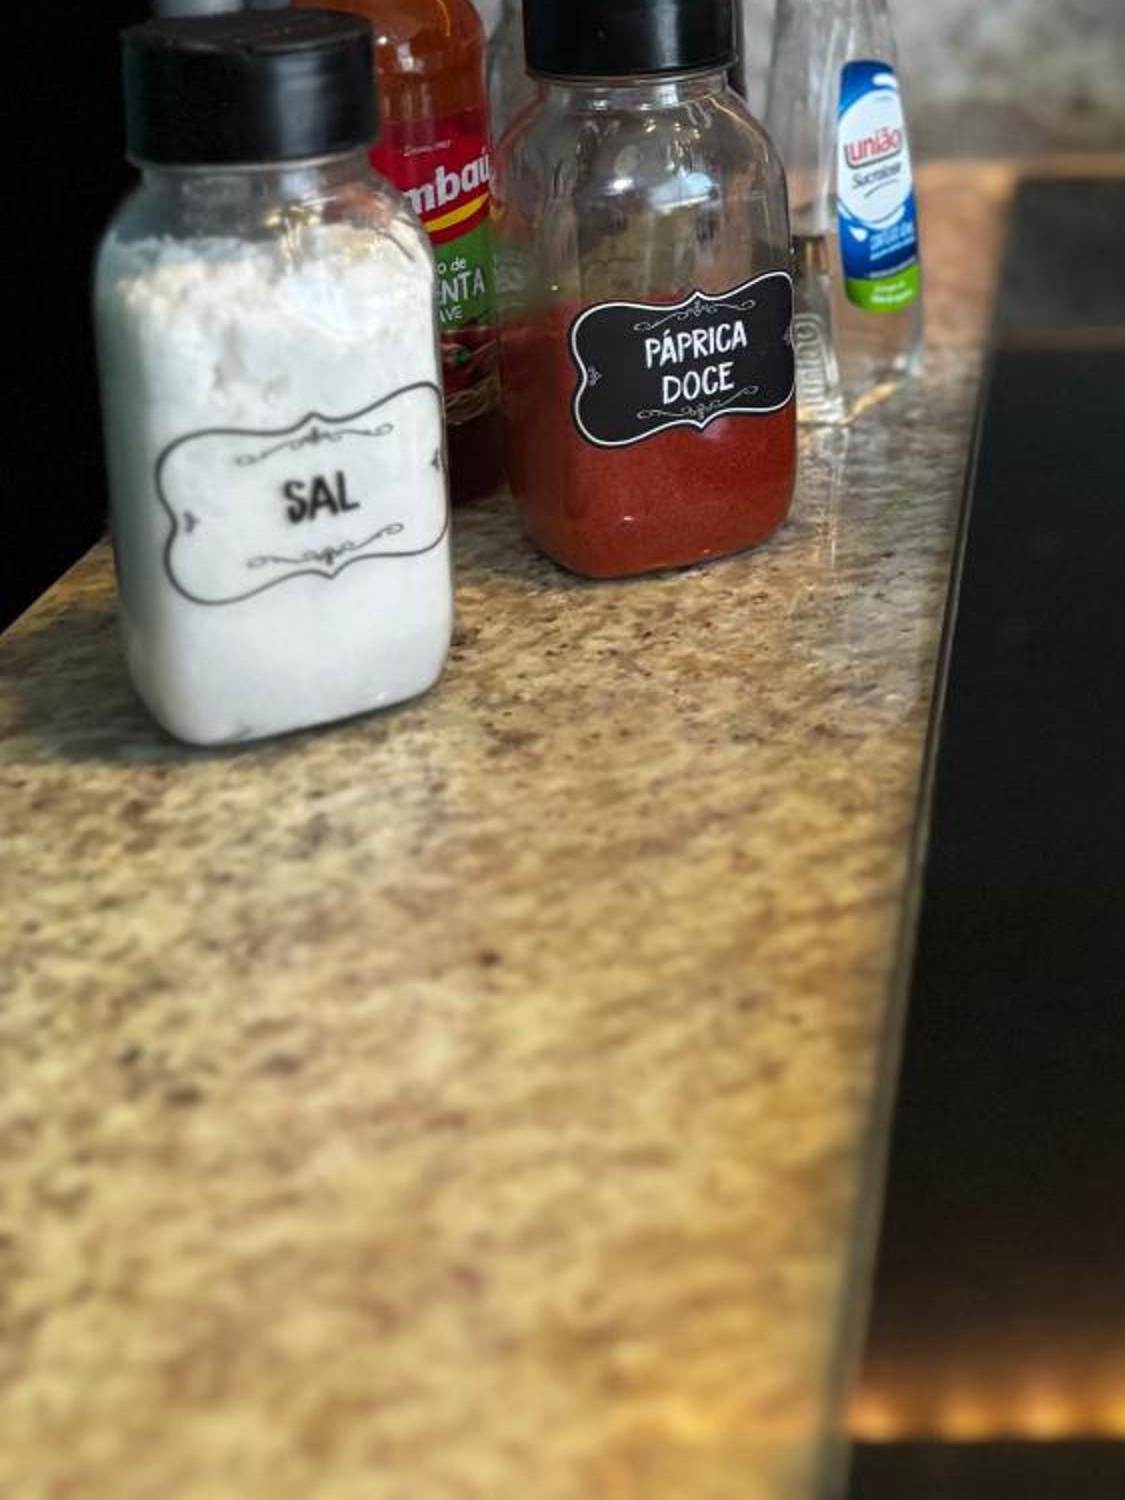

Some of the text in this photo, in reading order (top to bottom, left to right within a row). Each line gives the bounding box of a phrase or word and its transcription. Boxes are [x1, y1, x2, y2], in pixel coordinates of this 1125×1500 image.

[846, 126, 902, 162] união
[402, 145, 489, 214] mbaú
[439, 267, 485, 305] NTA
[645, 320, 747, 369] PÁPRICA
[662, 361, 734, 405] DOCE
[282, 469, 361, 525] SAL
